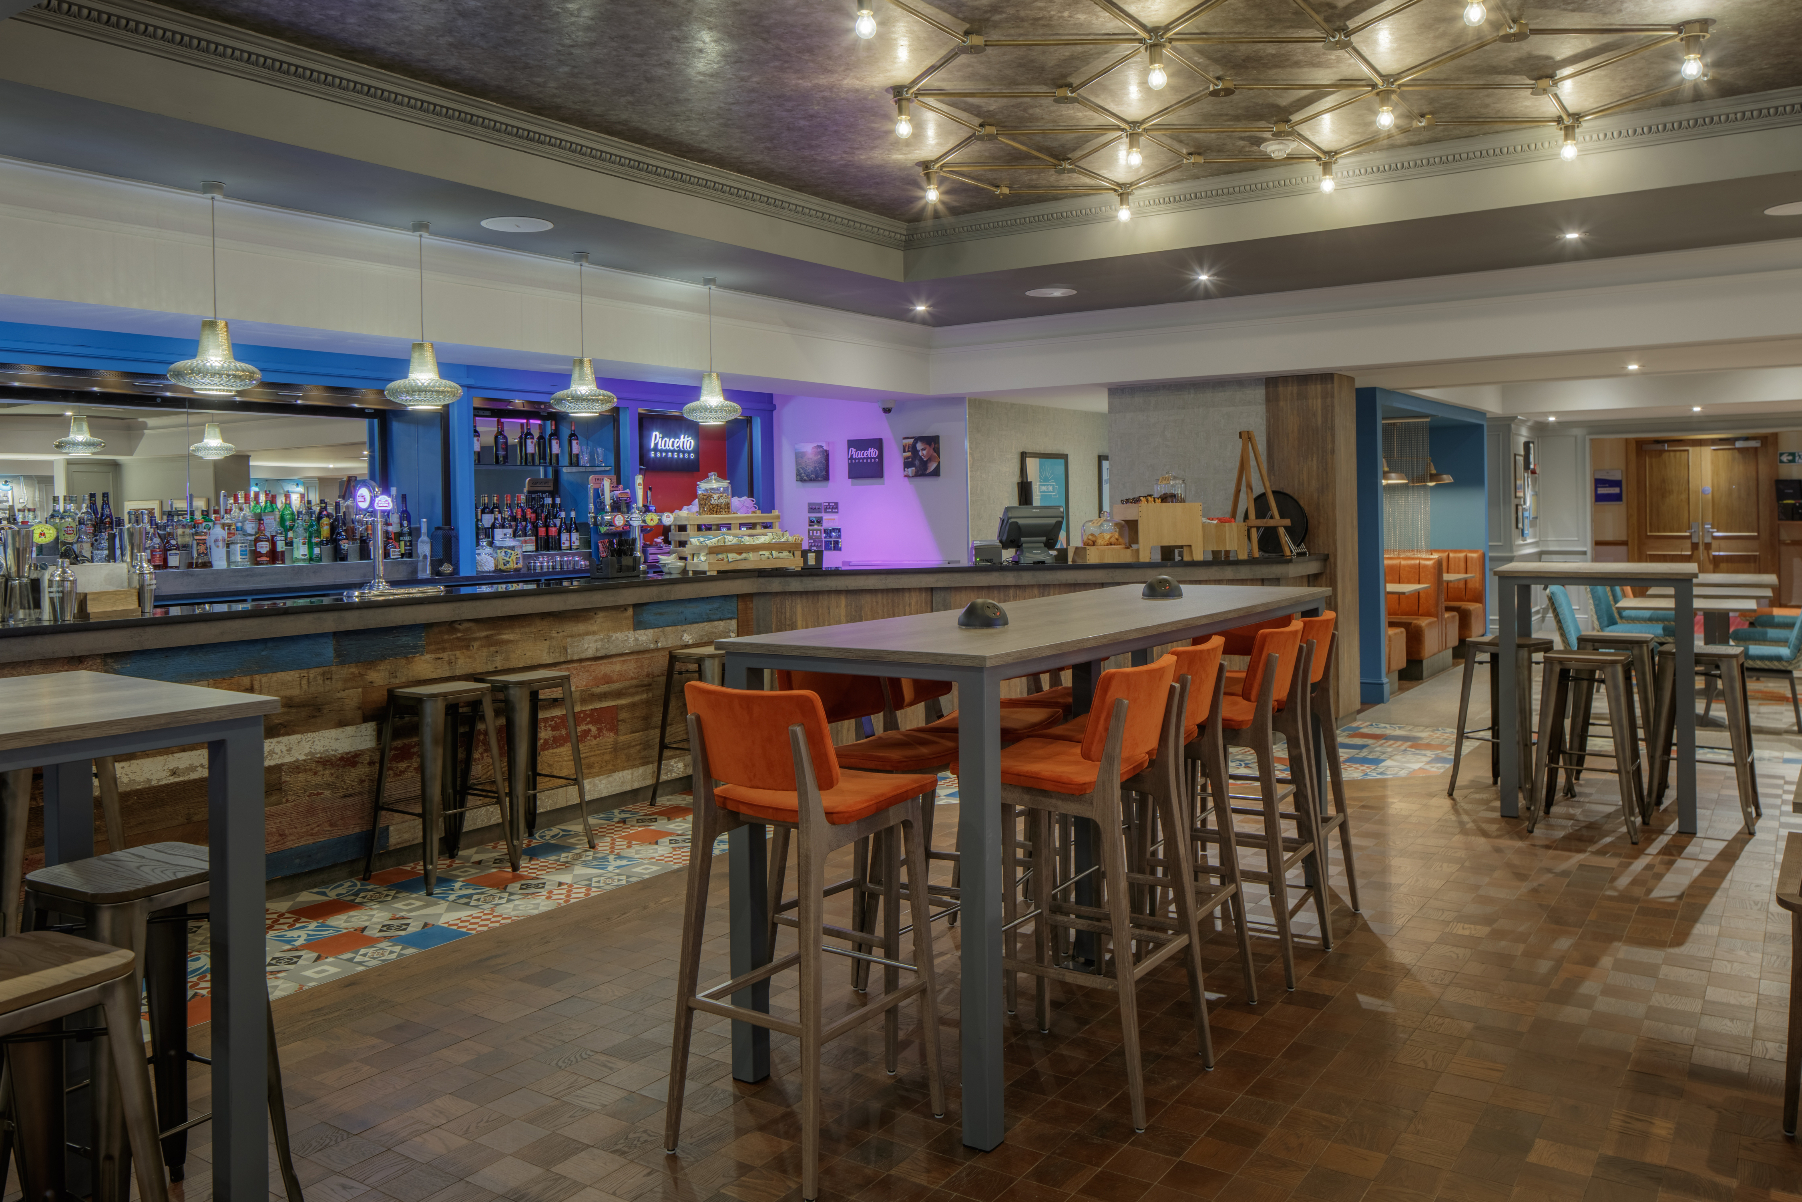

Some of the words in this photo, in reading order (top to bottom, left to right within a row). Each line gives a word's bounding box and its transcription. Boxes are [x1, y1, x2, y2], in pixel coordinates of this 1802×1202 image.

[650, 431, 695, 451] Piacetto
[650, 451, 695, 459] ESPRESSO
[848, 447, 879, 459] Piacetto
